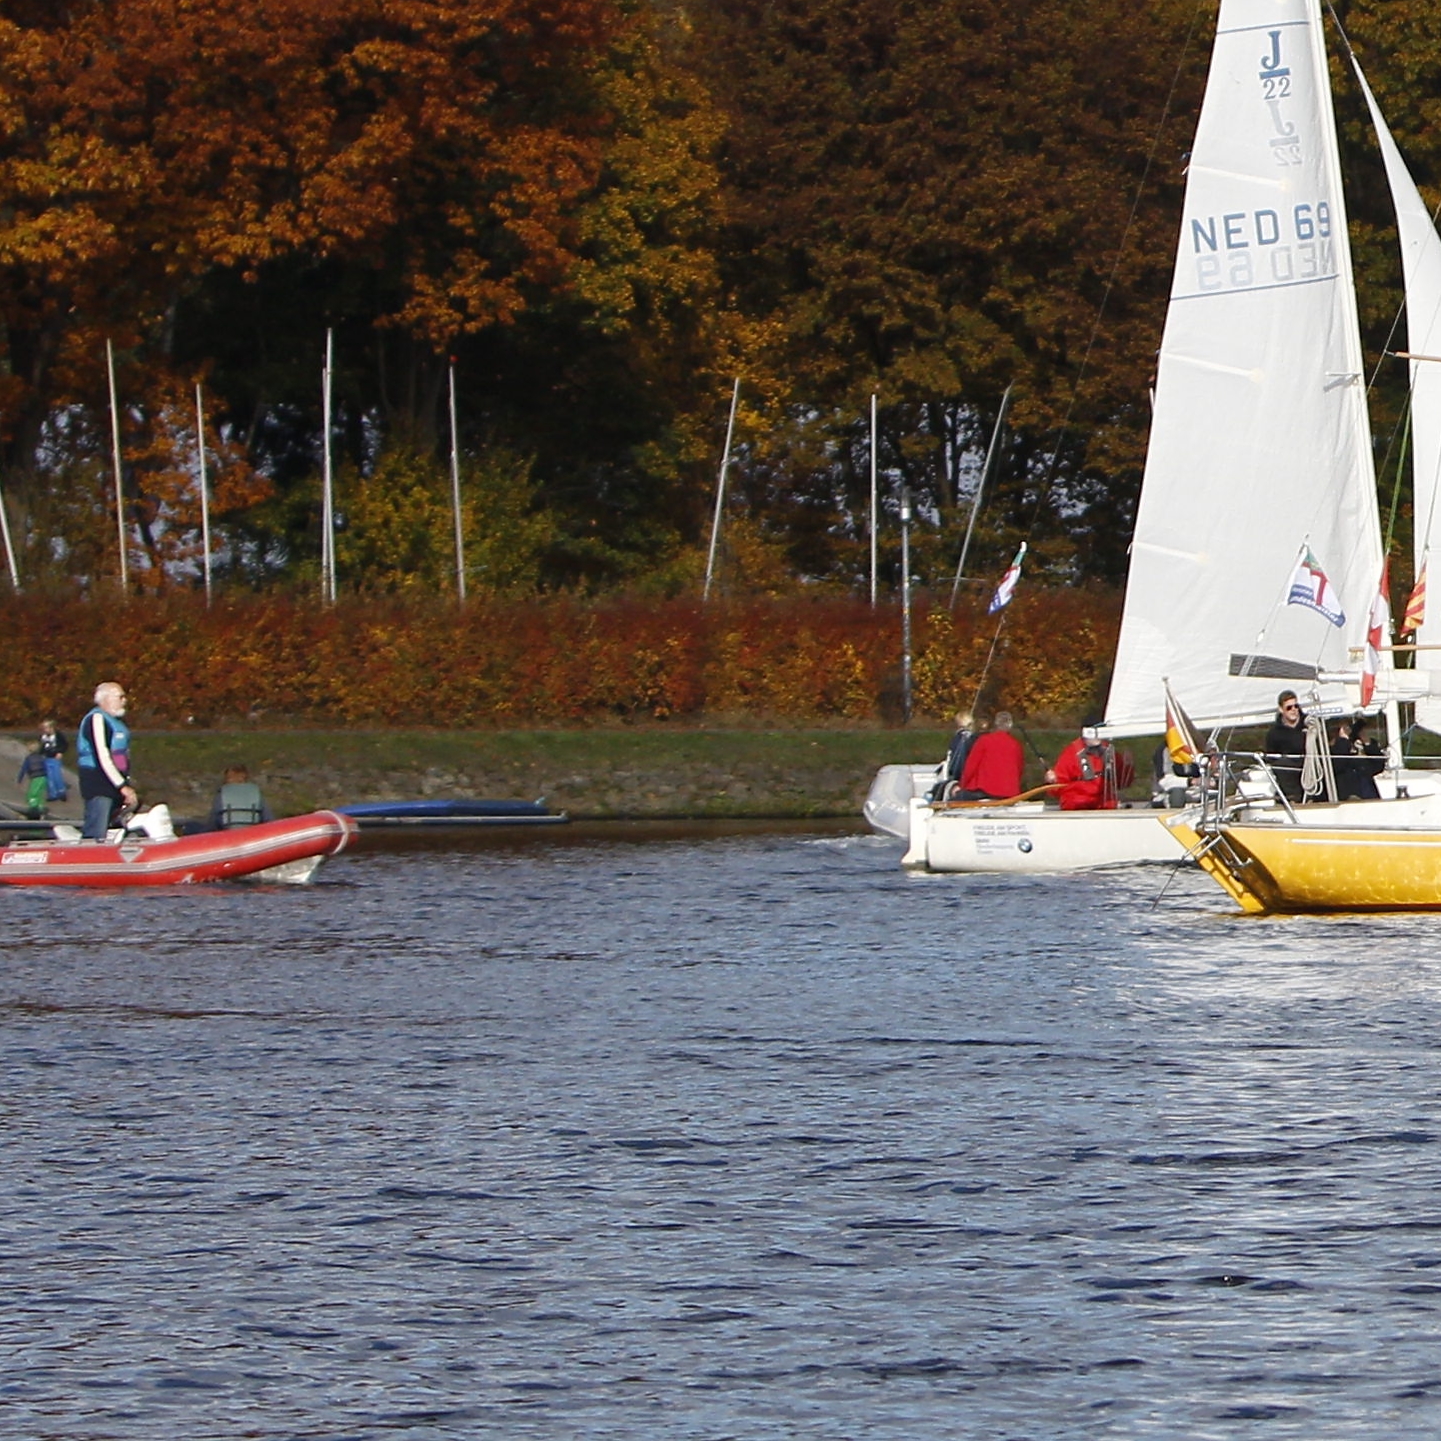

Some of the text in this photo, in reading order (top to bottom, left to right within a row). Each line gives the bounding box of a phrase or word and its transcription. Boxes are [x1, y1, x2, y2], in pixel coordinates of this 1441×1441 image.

[1261, 30, 1282, 70] J
[1263, 77, 1291, 100] 22
[1191, 201, 1331, 253] NED 69
